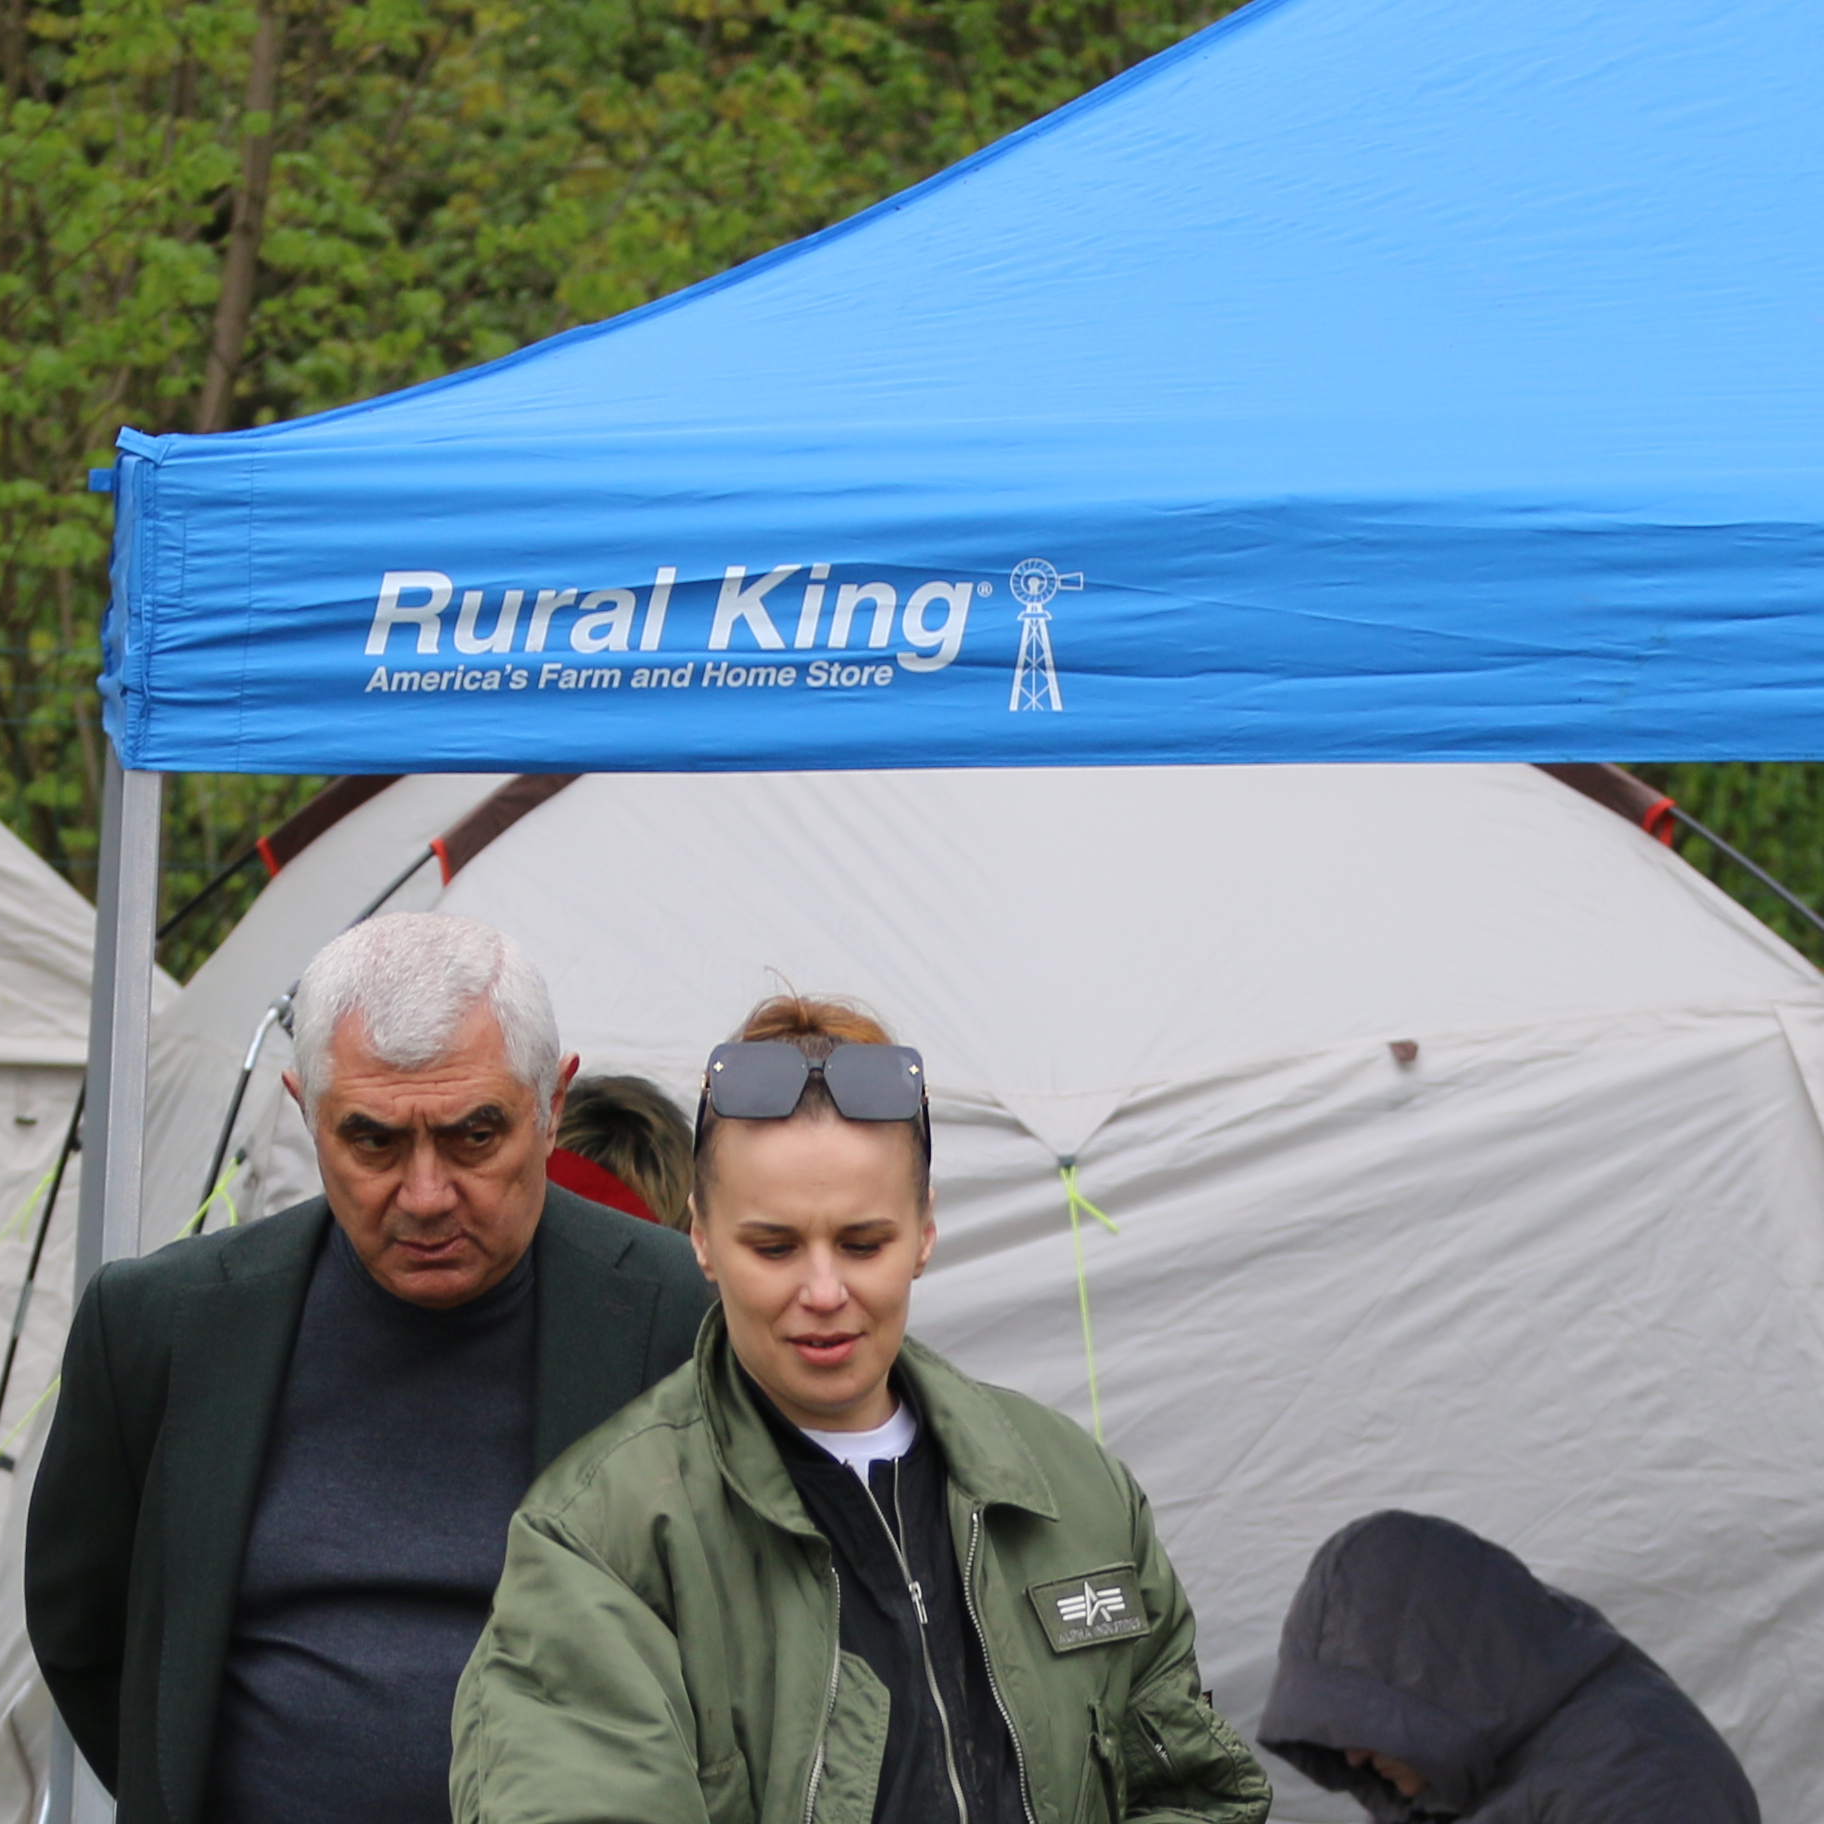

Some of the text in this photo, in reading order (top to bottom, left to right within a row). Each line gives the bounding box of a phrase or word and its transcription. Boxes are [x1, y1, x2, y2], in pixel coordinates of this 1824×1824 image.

[364, 563, 973, 673] Rural King
[365, 660, 893, 692] America's Farm and Home Store
